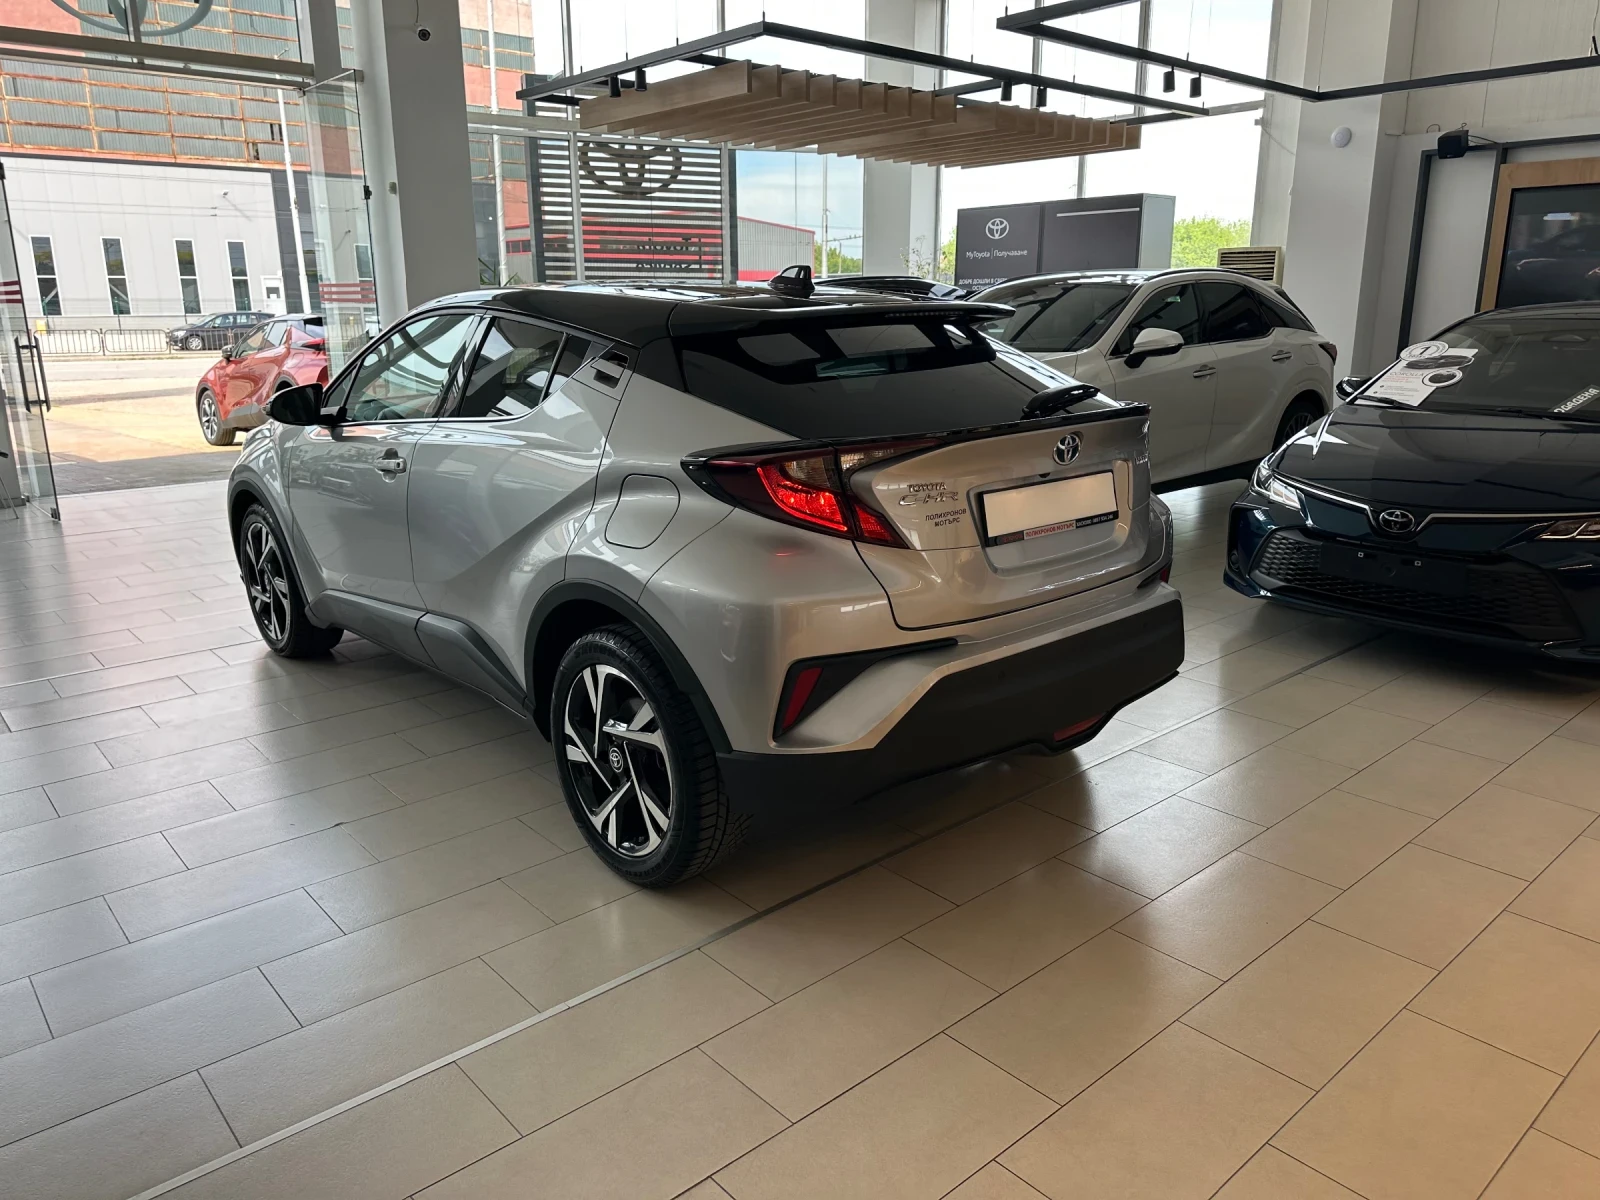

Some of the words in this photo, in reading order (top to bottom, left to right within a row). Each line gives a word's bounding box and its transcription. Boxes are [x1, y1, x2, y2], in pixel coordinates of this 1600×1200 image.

[966, 251, 990, 259] MyToyota
[993, 249, 1028, 258] Получаване
[907, 482, 947, 493] TOYOTA
[898, 492, 959, 506] C-HR
[925, 508, 967, 521] ПОЛИХРОНОВ
[934, 517, 961, 527] МОТЪРС
[1025, 526, 1056, 538] ПОЛИХРОНОВ
[1056, 522, 1075, 531] МОТЪРС
